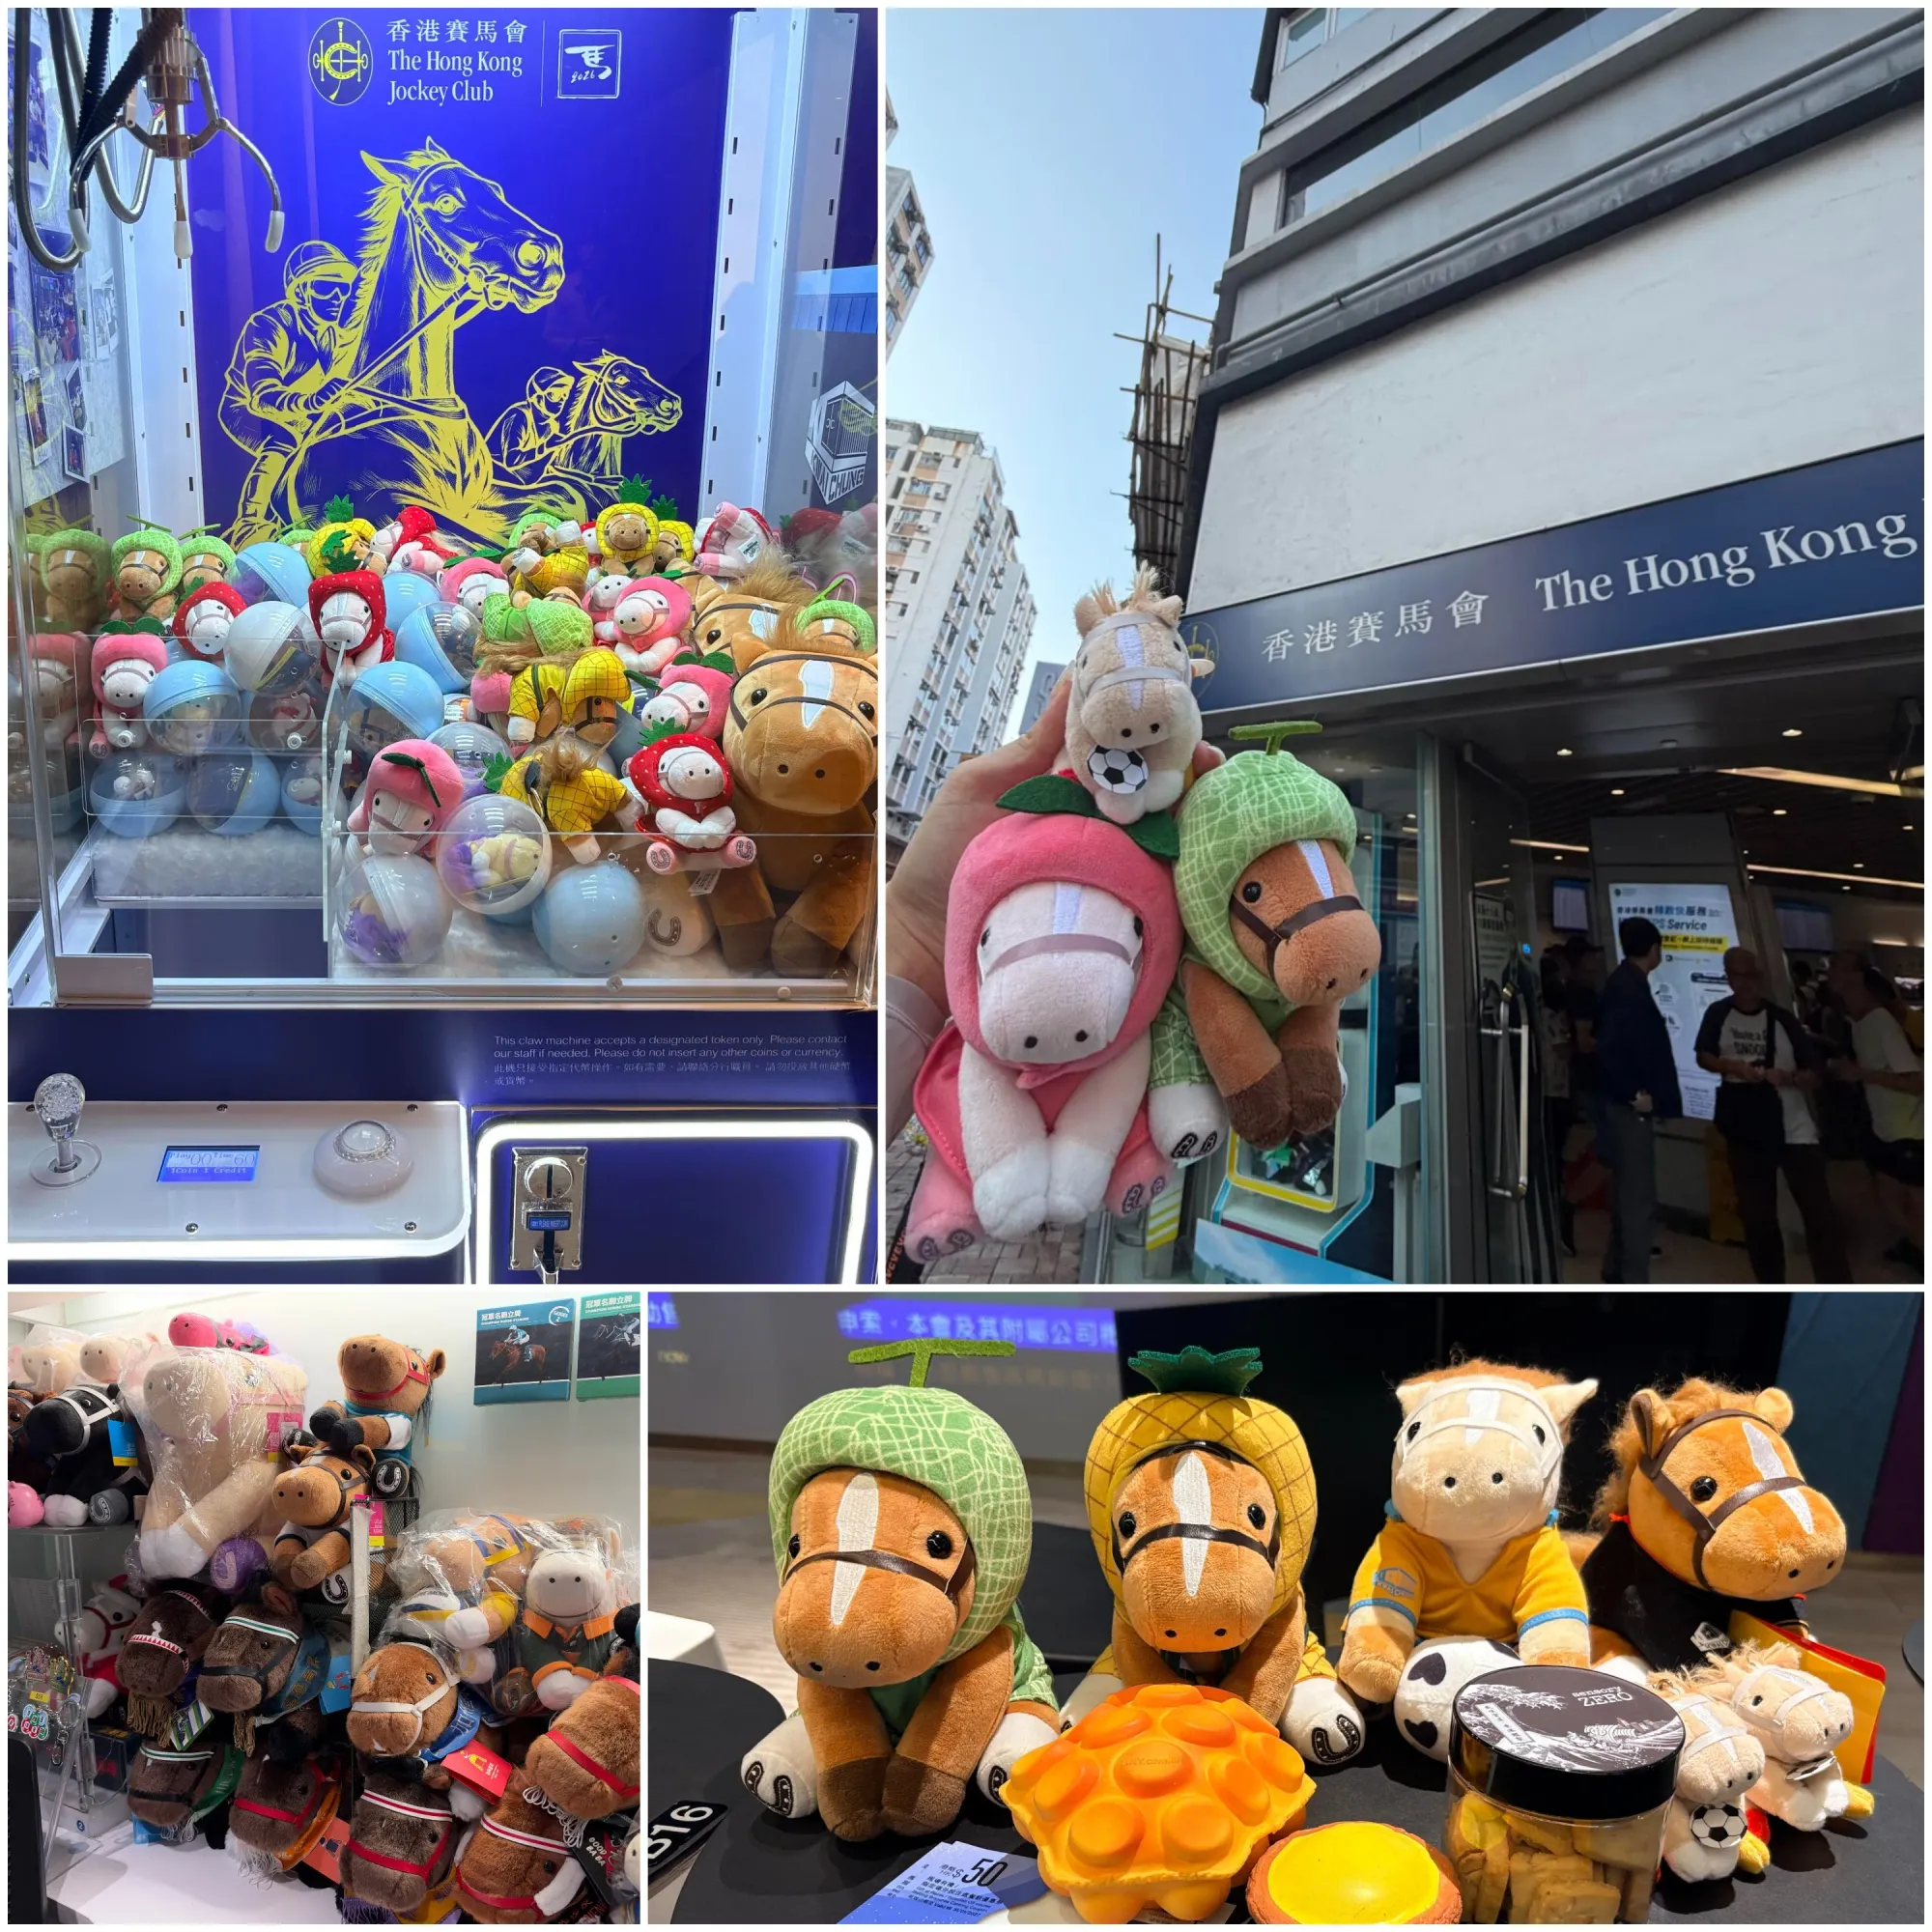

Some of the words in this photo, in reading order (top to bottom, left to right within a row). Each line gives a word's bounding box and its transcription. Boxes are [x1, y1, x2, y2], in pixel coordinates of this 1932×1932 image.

[386, 18, 528, 43] 香港賽馬會
[387, 49, 421, 71] The
[426, 50, 473, 76] Hong
[477, 50, 523, 76] Kong
[387, 79, 448, 106] Jockey
[451, 80, 494, 101] Club
[828, 467, 866, 501] CHUNG
[1535, 567, 1614, 612] The
[1624, 544, 1755, 595] Hong
[1760, 511, 1918, 572] Kong
[1261, 589, 1490, 664] 香港賽馬會
[1666, 918, 1708, 931] Service
[494, 1036, 516, 1045] This
[518, 1036, 543, 1045] claw
[546, 1036, 591, 1045] machine
[593, 1035, 637, 1046] accepts
[648, 1035, 708, 1046] designated
[711, 1035, 740, 1044] token
[770, 1034, 806, 1044] Please
[808, 1035, 847, 1044] contact
[514, 1048, 536, 1058] staff
[538, 1048, 545, 1058] if
[547, 1048, 591, 1058] needed.
[594, 1048, 629, 1058] Please
[632, 1048, 646, 1057] do
[648, 1048, 666, 1057] not
[668, 1048, 696, 1057] insert
[698, 1049, 719, 1059] any
[721, 1048, 747, 1057] other
[750, 1048, 779, 1057] coins
[794, 1049, 843, 1059] currency.
[1572, 1686, 1622, 1698] sensory
[1577, 1691, 1634, 1707] ZERO
[648, 1804, 713, 1860] B16
[588, 1836, 608, 1856] GOOD
